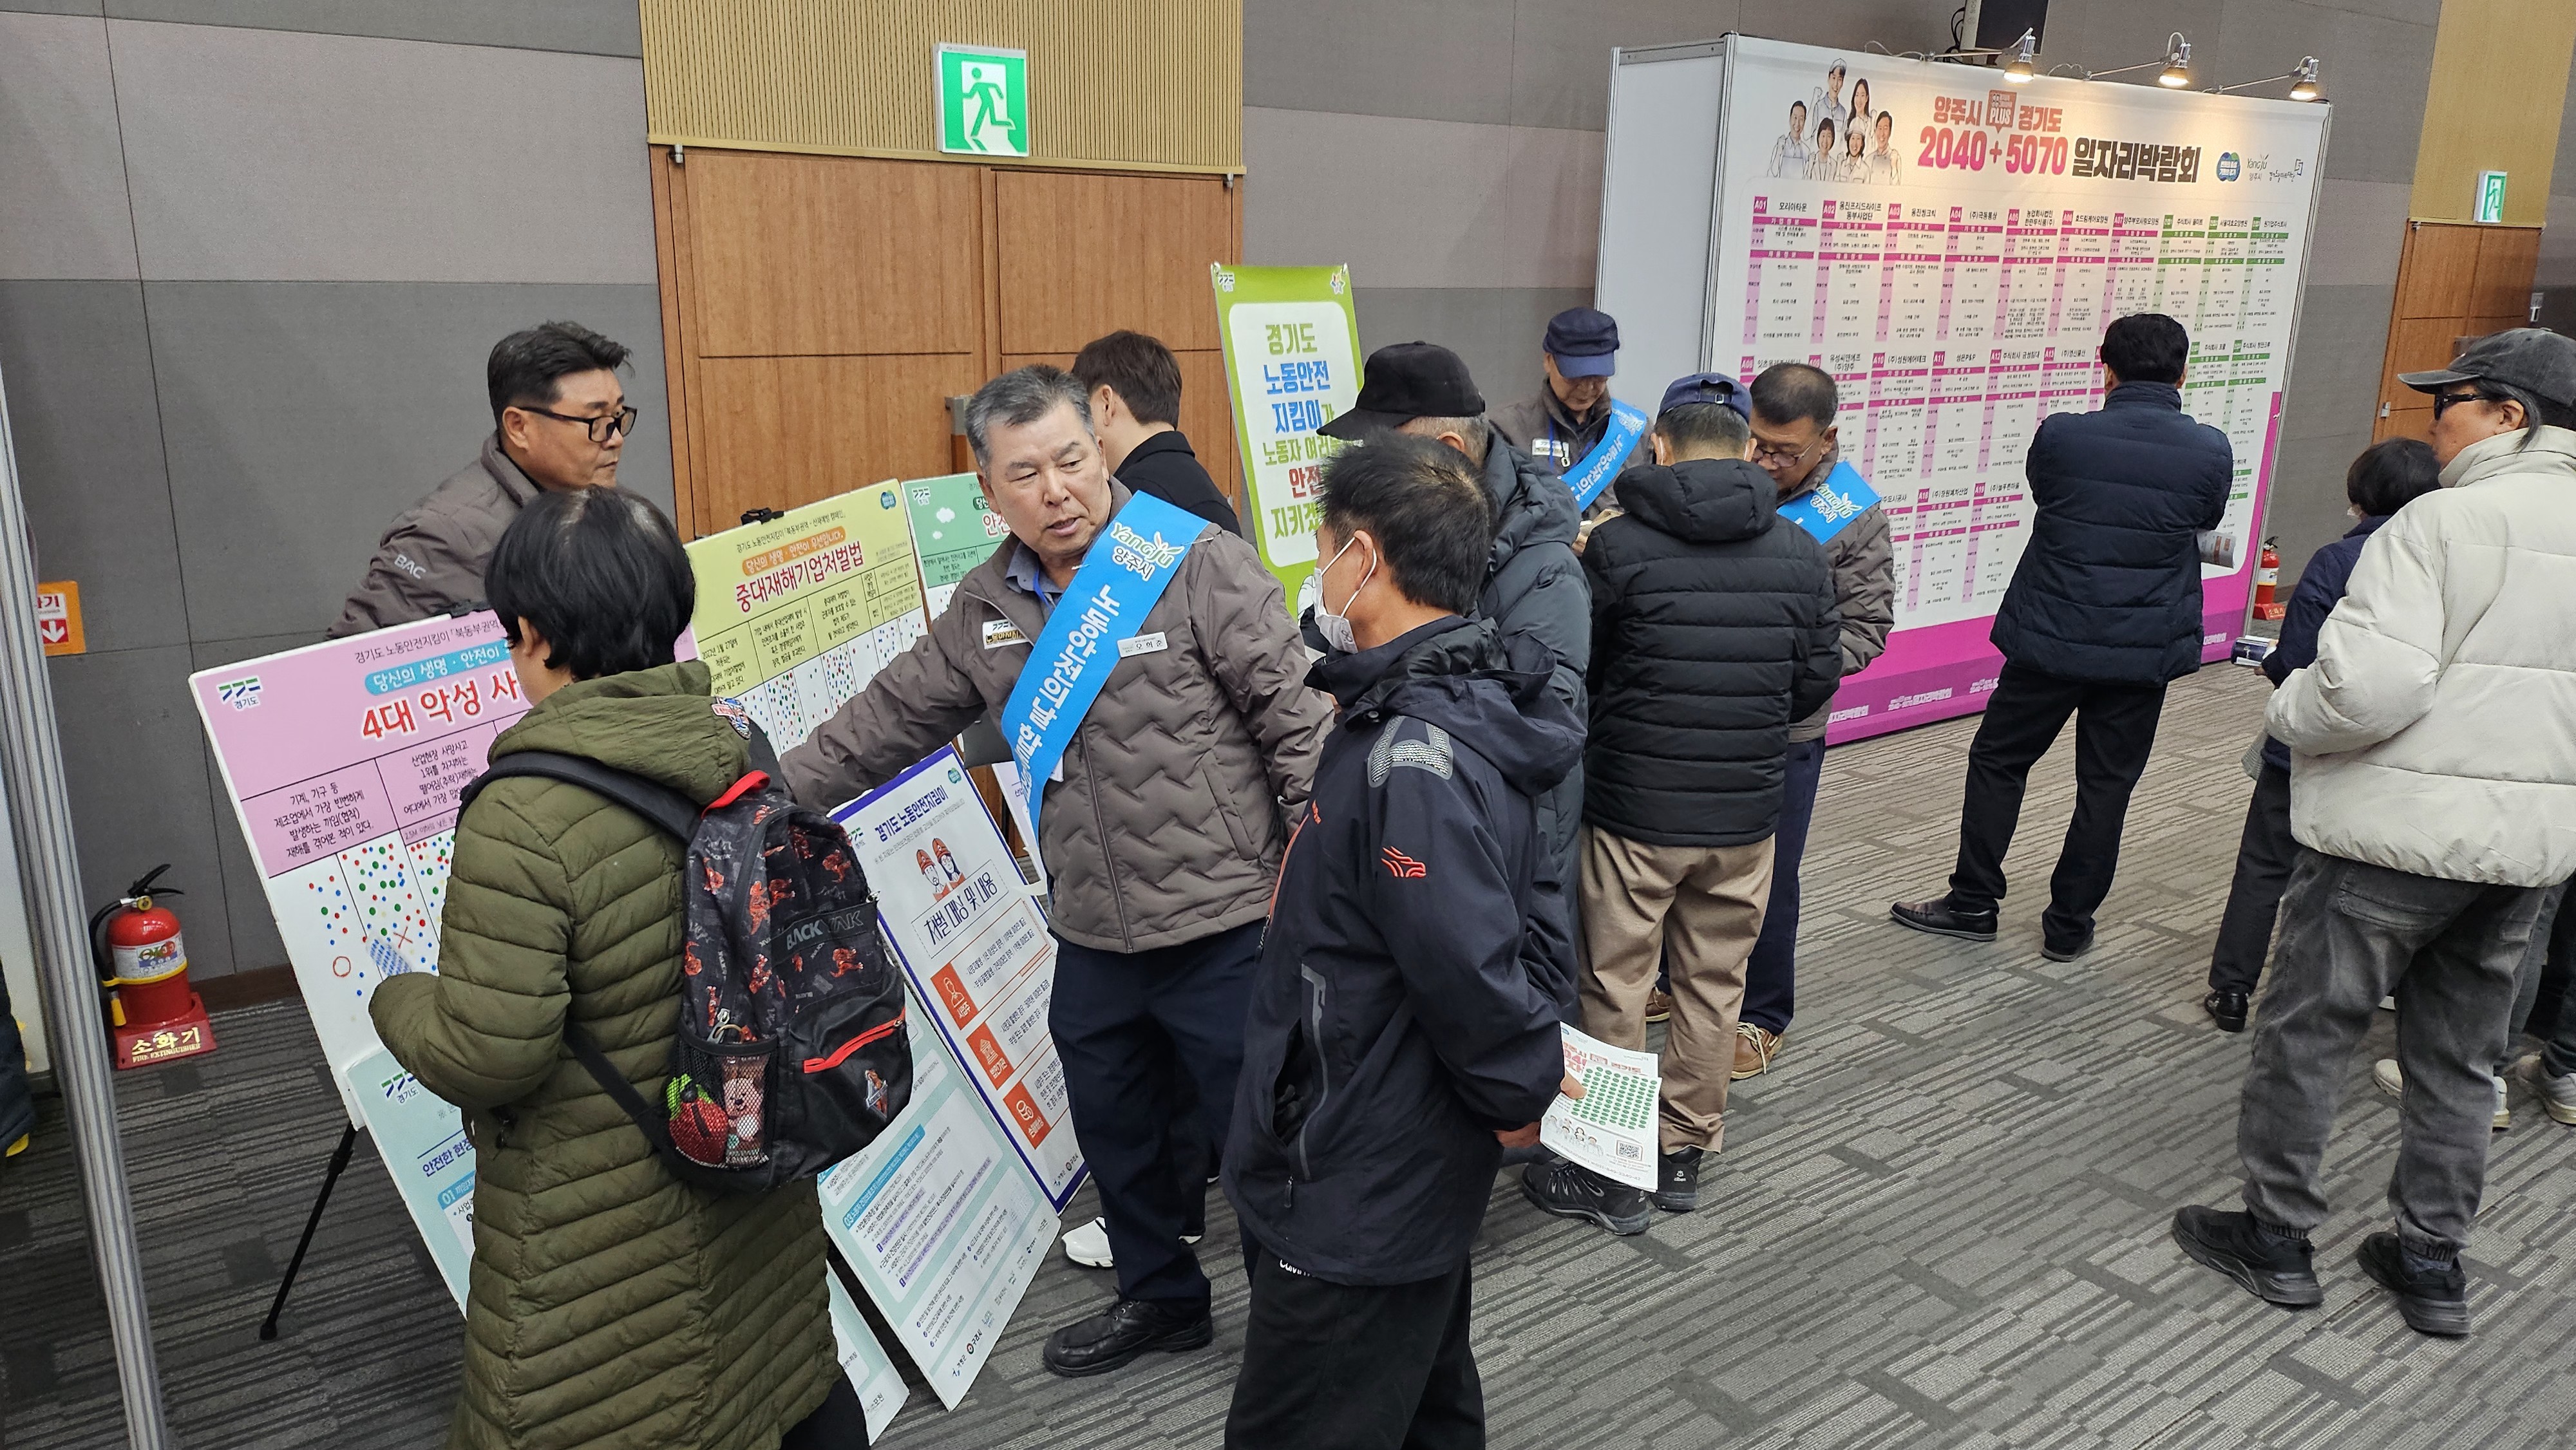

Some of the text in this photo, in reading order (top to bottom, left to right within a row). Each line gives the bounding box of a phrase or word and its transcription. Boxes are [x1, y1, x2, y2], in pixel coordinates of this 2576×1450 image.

[1933, 96, 1982, 126] 양주시
[1989, 107, 2012, 126] PLUS
[2018, 105, 2063, 133] 경기도
[2072, 137, 2201, 183] 일자리박람회
[2249, 173, 2262, 182] 양주시
[1754, 200, 1767, 211] A01
[1823, 206, 1835, 214] A02
[1950, 210, 1962, 220] A04
[2114, 216, 2124, 225] A07
[1265, 323, 1318, 355] 경기도
[1933, 354, 1944, 362] A11
[1991, 352, 2002, 361] A12
[2003, 351, 2021, 359] 주식회사
[1263, 361, 1331, 395] 노동안전
[1271, 399, 1336, 435] 지킴이가
[1263, 438, 1302, 466] 노동자
[1975, 484, 1985, 494] A19
[1810, 495, 1837, 523] 양주시
[736, 541, 752, 553] 경기도
[752, 531, 785, 547] 노동안전지킴이
[746, 529, 844, 574] 당신의 생명 안전이 우선입니다.
[393, 554, 426, 579] BAC
[735, 541, 864, 614] 중대재해기업처벌법
[1112, 546, 1156, 582] 양주시
[354, 646, 384, 664] 경기도
[385, 630, 450, 655] 노동안전지킴이
[374, 645, 500, 692] 당신의 생명 안전이
[233, 696, 260, 711] 경기도
[360, 700, 414, 741] 4대
[421, 680, 481, 726] 악성
[411, 740, 469, 767] 산업현장 사망사고
[421, 755, 469, 778] 1위를 차지하는
[290, 782, 338, 807] 기계, 가구 등
[403, 792, 448, 815] 어디에서 가장
[274, 790, 365, 828] 제조업에서 가장 빈번하게
[875, 786, 949, 841] 경기도 노동안전지킴이
[290, 807, 360, 841] 발생하는 끼임(협착)
[286, 842, 310, 858] 재해를
[313, 833, 336, 849] 겪어본
[339, 826, 354, 840] 적이
[923, 872, 997, 942] 처벌 대상 및 내용
[131, 1026, 201, 1056] 소화기
[132, 1042, 202, 1064] FIRE EXTINGUISHER
[397, 1087, 418, 1104] 경기도
[422, 1150, 453, 1177] 안전한
[442, 1191, 456, 1205] 01
[844, 1214, 855, 1226] 03
[969, 1329, 983, 1345] 구리시
